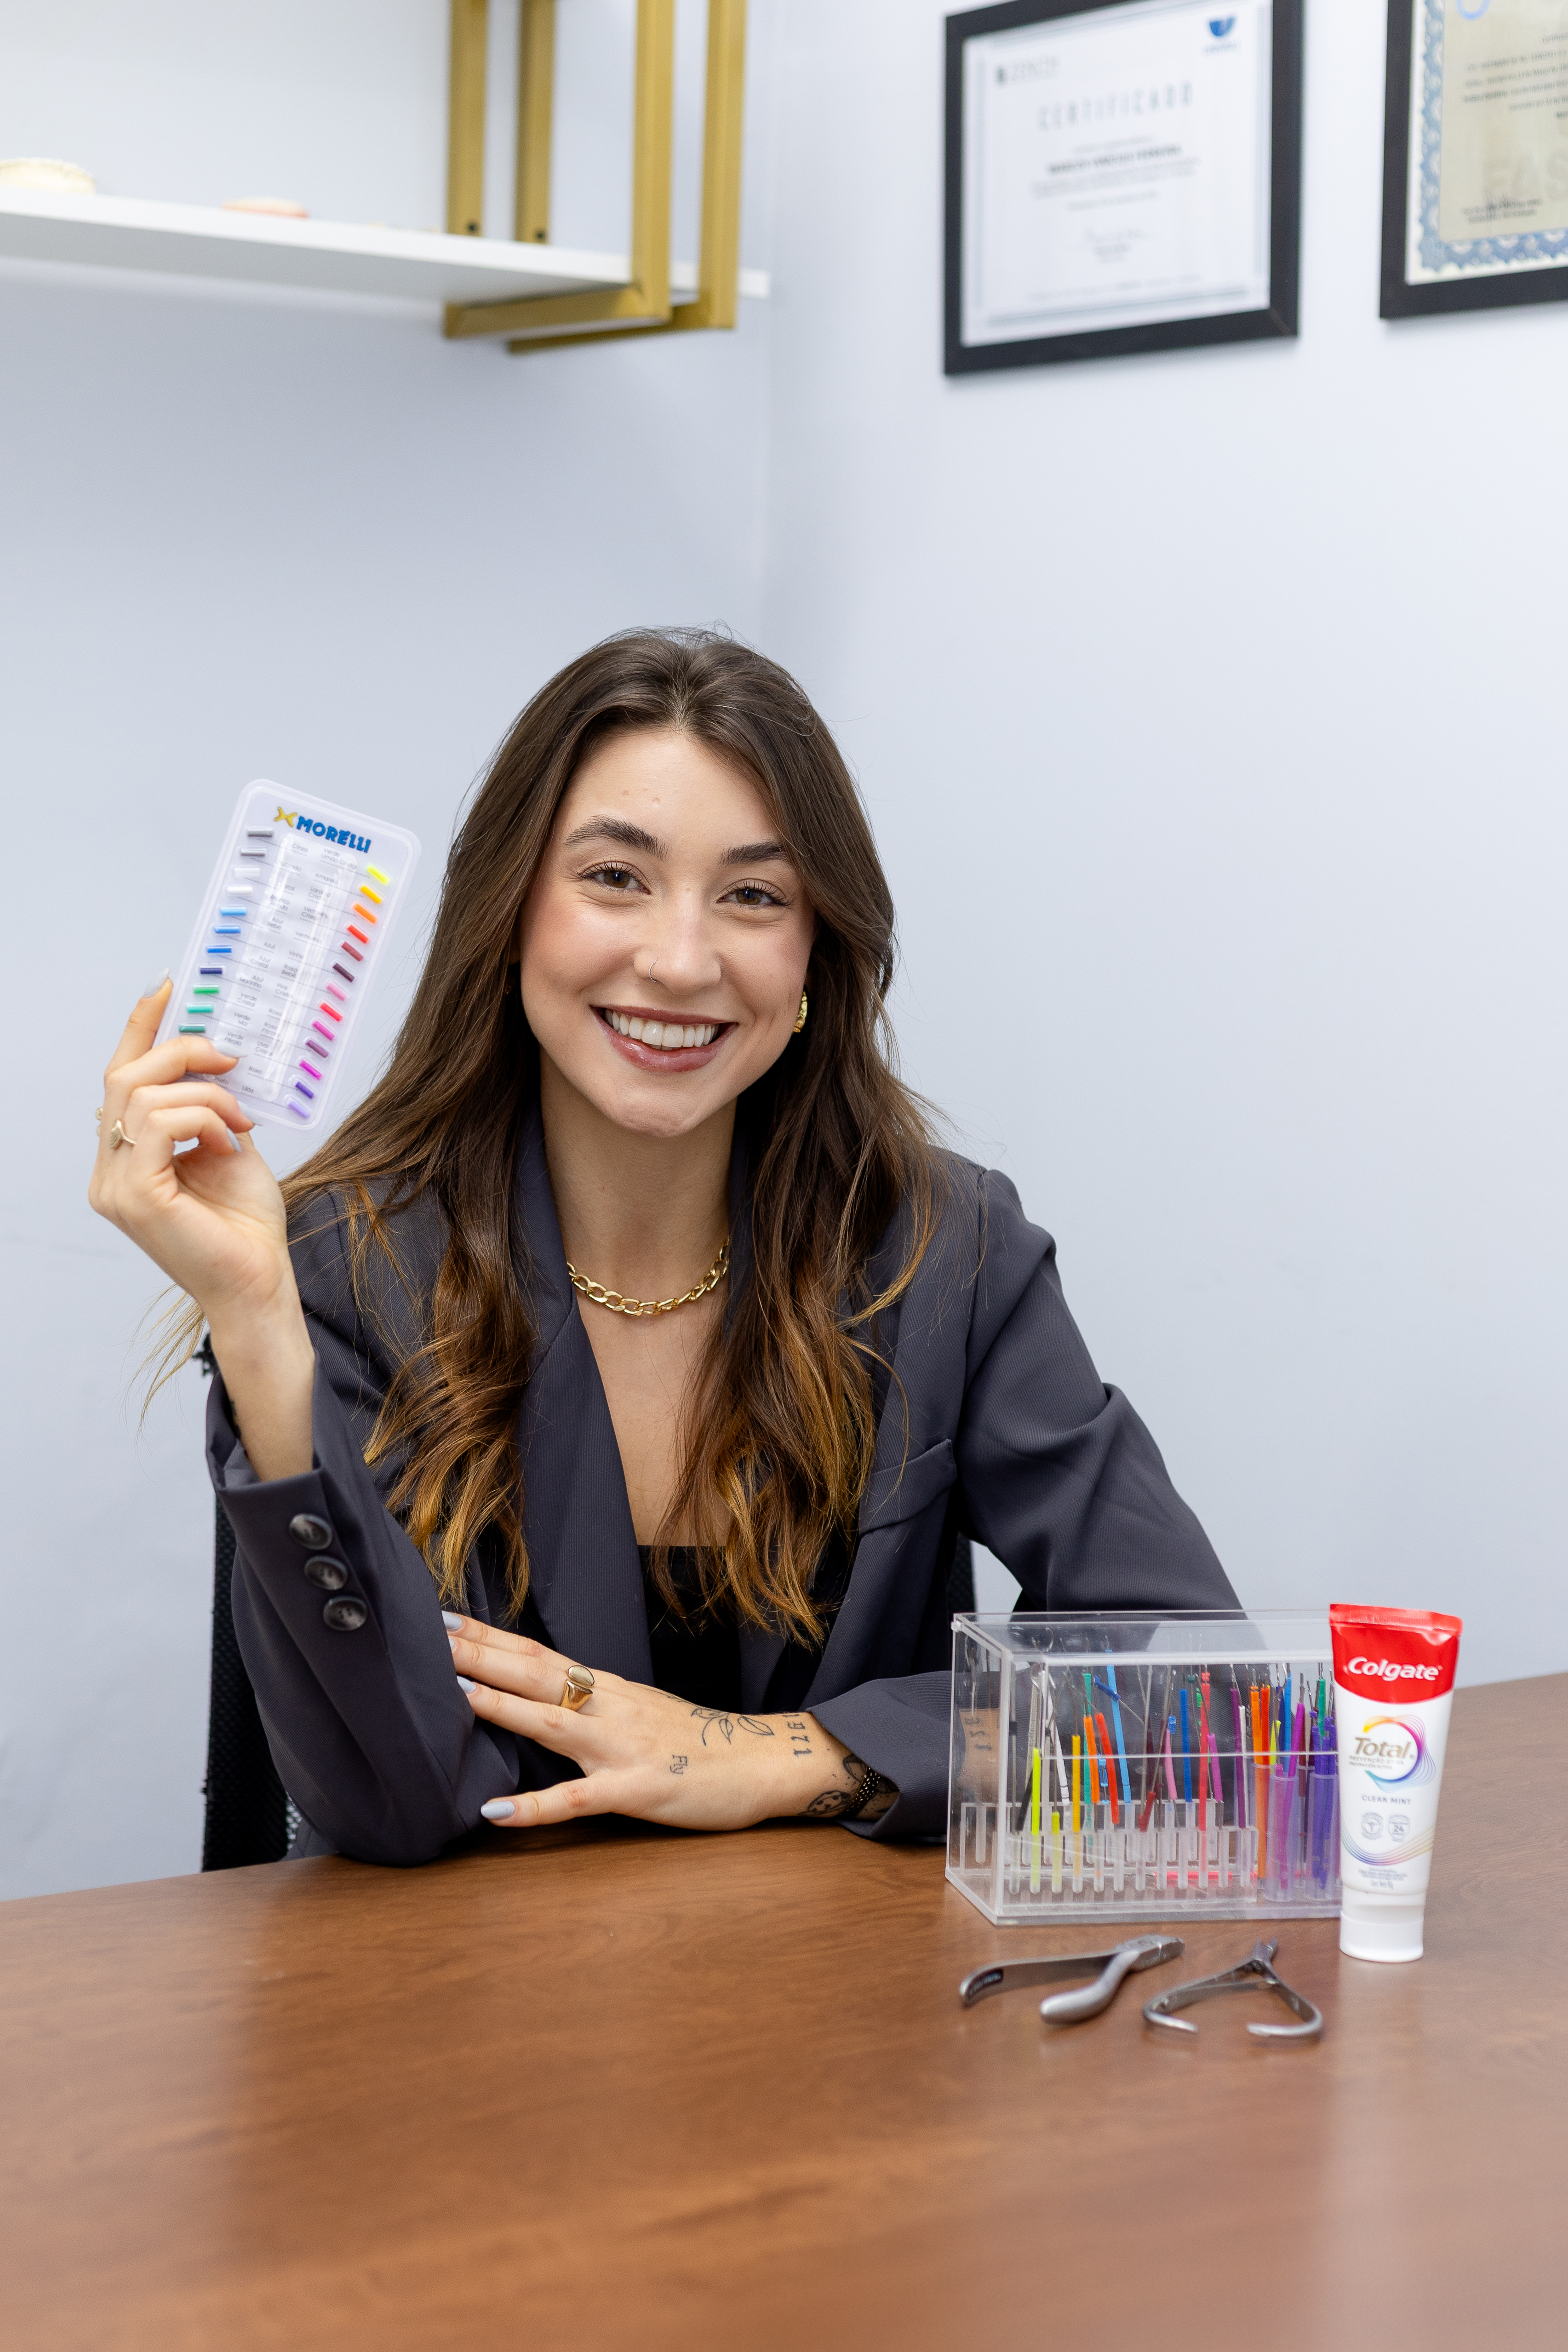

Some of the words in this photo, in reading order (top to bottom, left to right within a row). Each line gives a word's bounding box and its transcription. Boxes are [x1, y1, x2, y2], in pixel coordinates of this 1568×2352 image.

[296, 816, 372, 853] MORELLI
[250, 959, 269, 968] Cristal
[240, 993, 257, 1001] Verde
[237, 998, 255, 1007] Cristal
[235, 1013, 250, 1021] Verde
[228, 1031, 243, 1040] Verde
[1347, 1656, 1439, 1681] Colgate
[1355, 1737, 1411, 1759] Total
[670, 1754, 687, 1775] Fly
[1362, 1795, 1388, 1803] CLEAN
